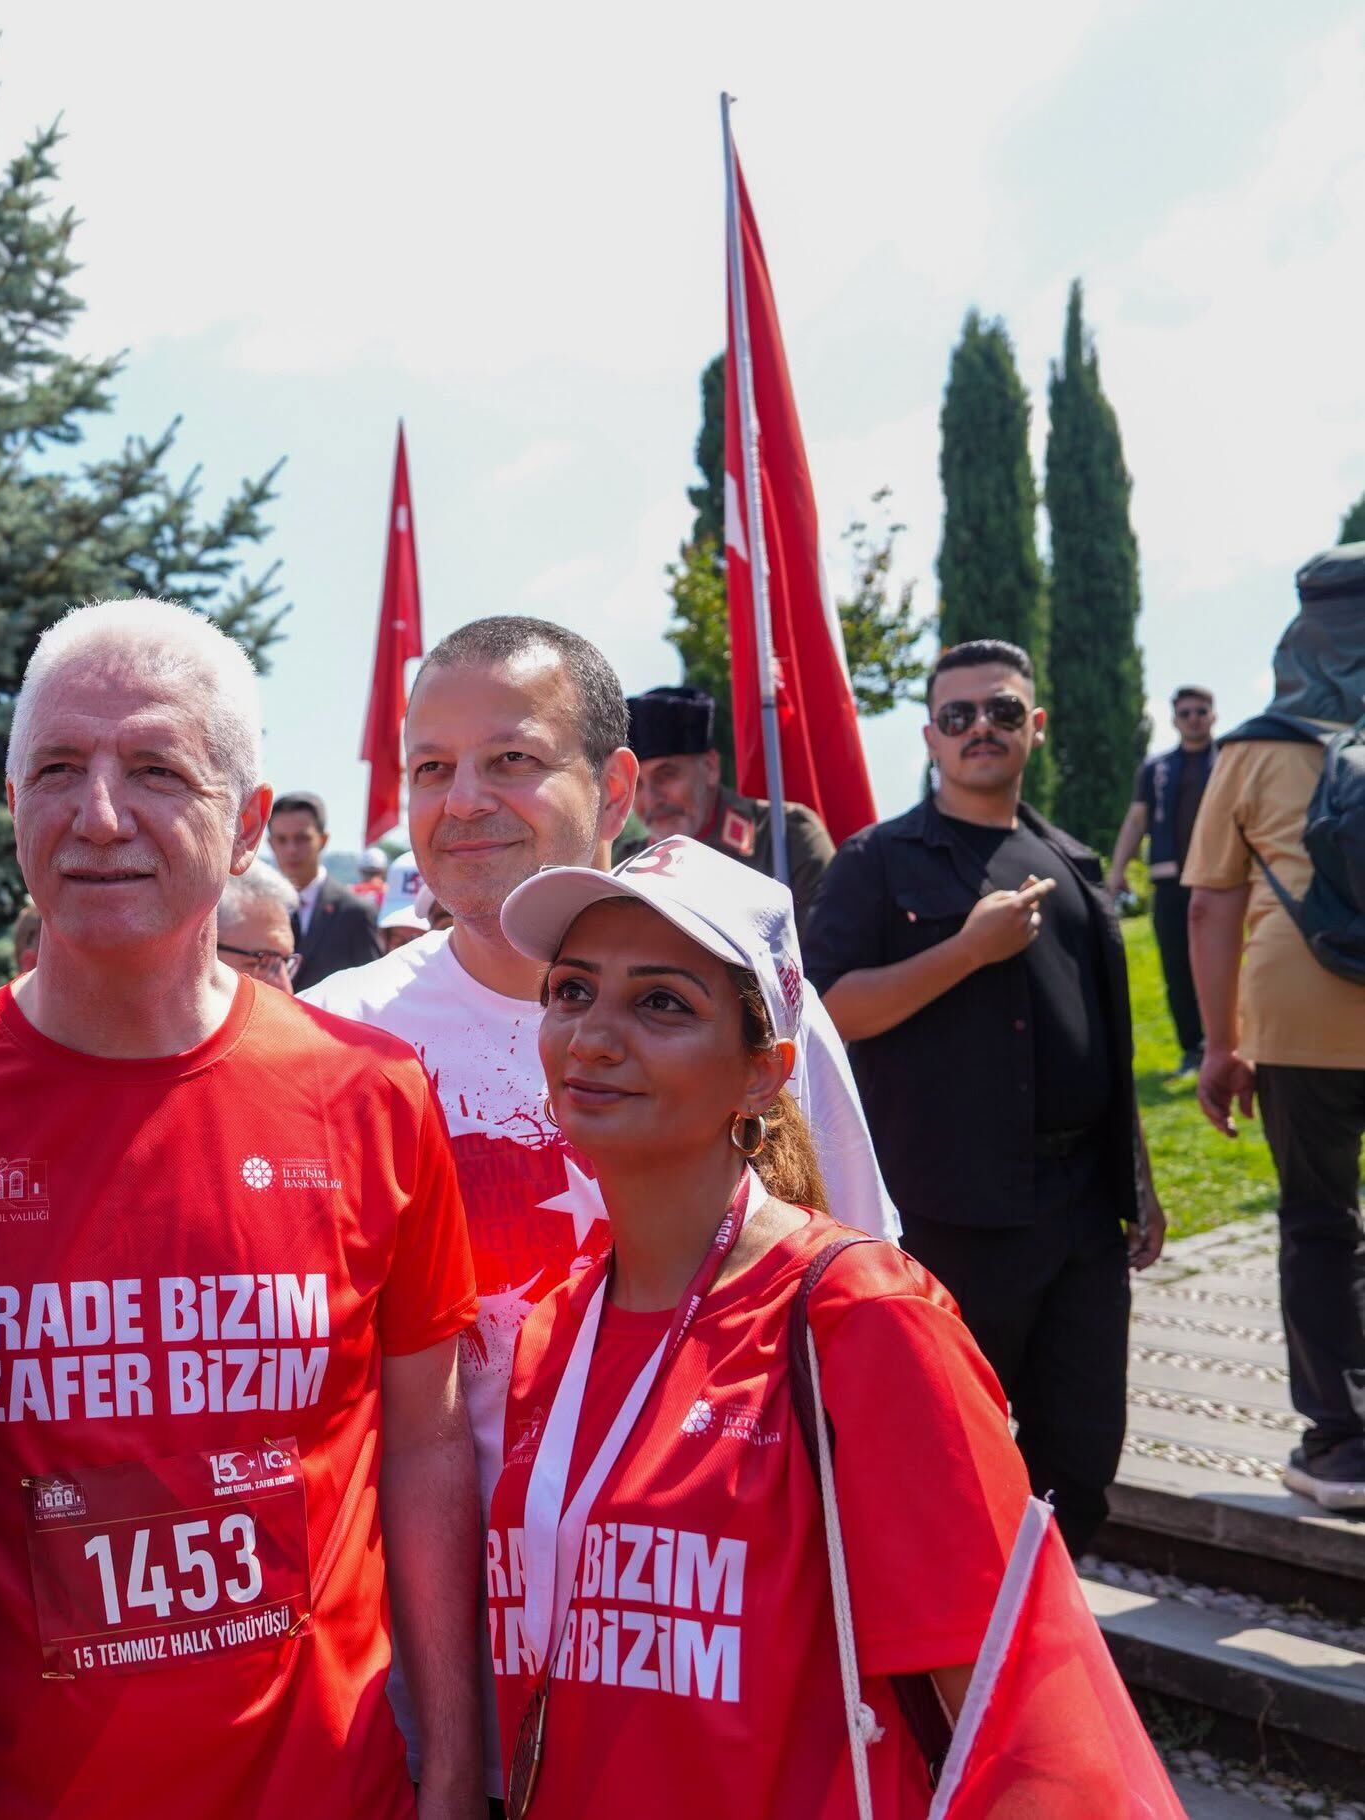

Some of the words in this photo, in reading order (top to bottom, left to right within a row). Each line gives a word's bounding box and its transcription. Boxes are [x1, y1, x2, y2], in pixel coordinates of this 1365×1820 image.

[159, 1273, 330, 1342] BİZİM
[168, 1346, 330, 1415] BİZİM
[84, 1513, 263, 1625] 1453
[579, 1523, 748, 1616] BİZİM
[73, 1648, 94, 1669] 15
[97, 1636, 168, 1666] TEMMUZ
[170, 1626, 214, 1657] HALK
[215, 1605, 291, 1648] YÜRÜYÜŞÜ
[579, 1608, 741, 1703] BİZİM
